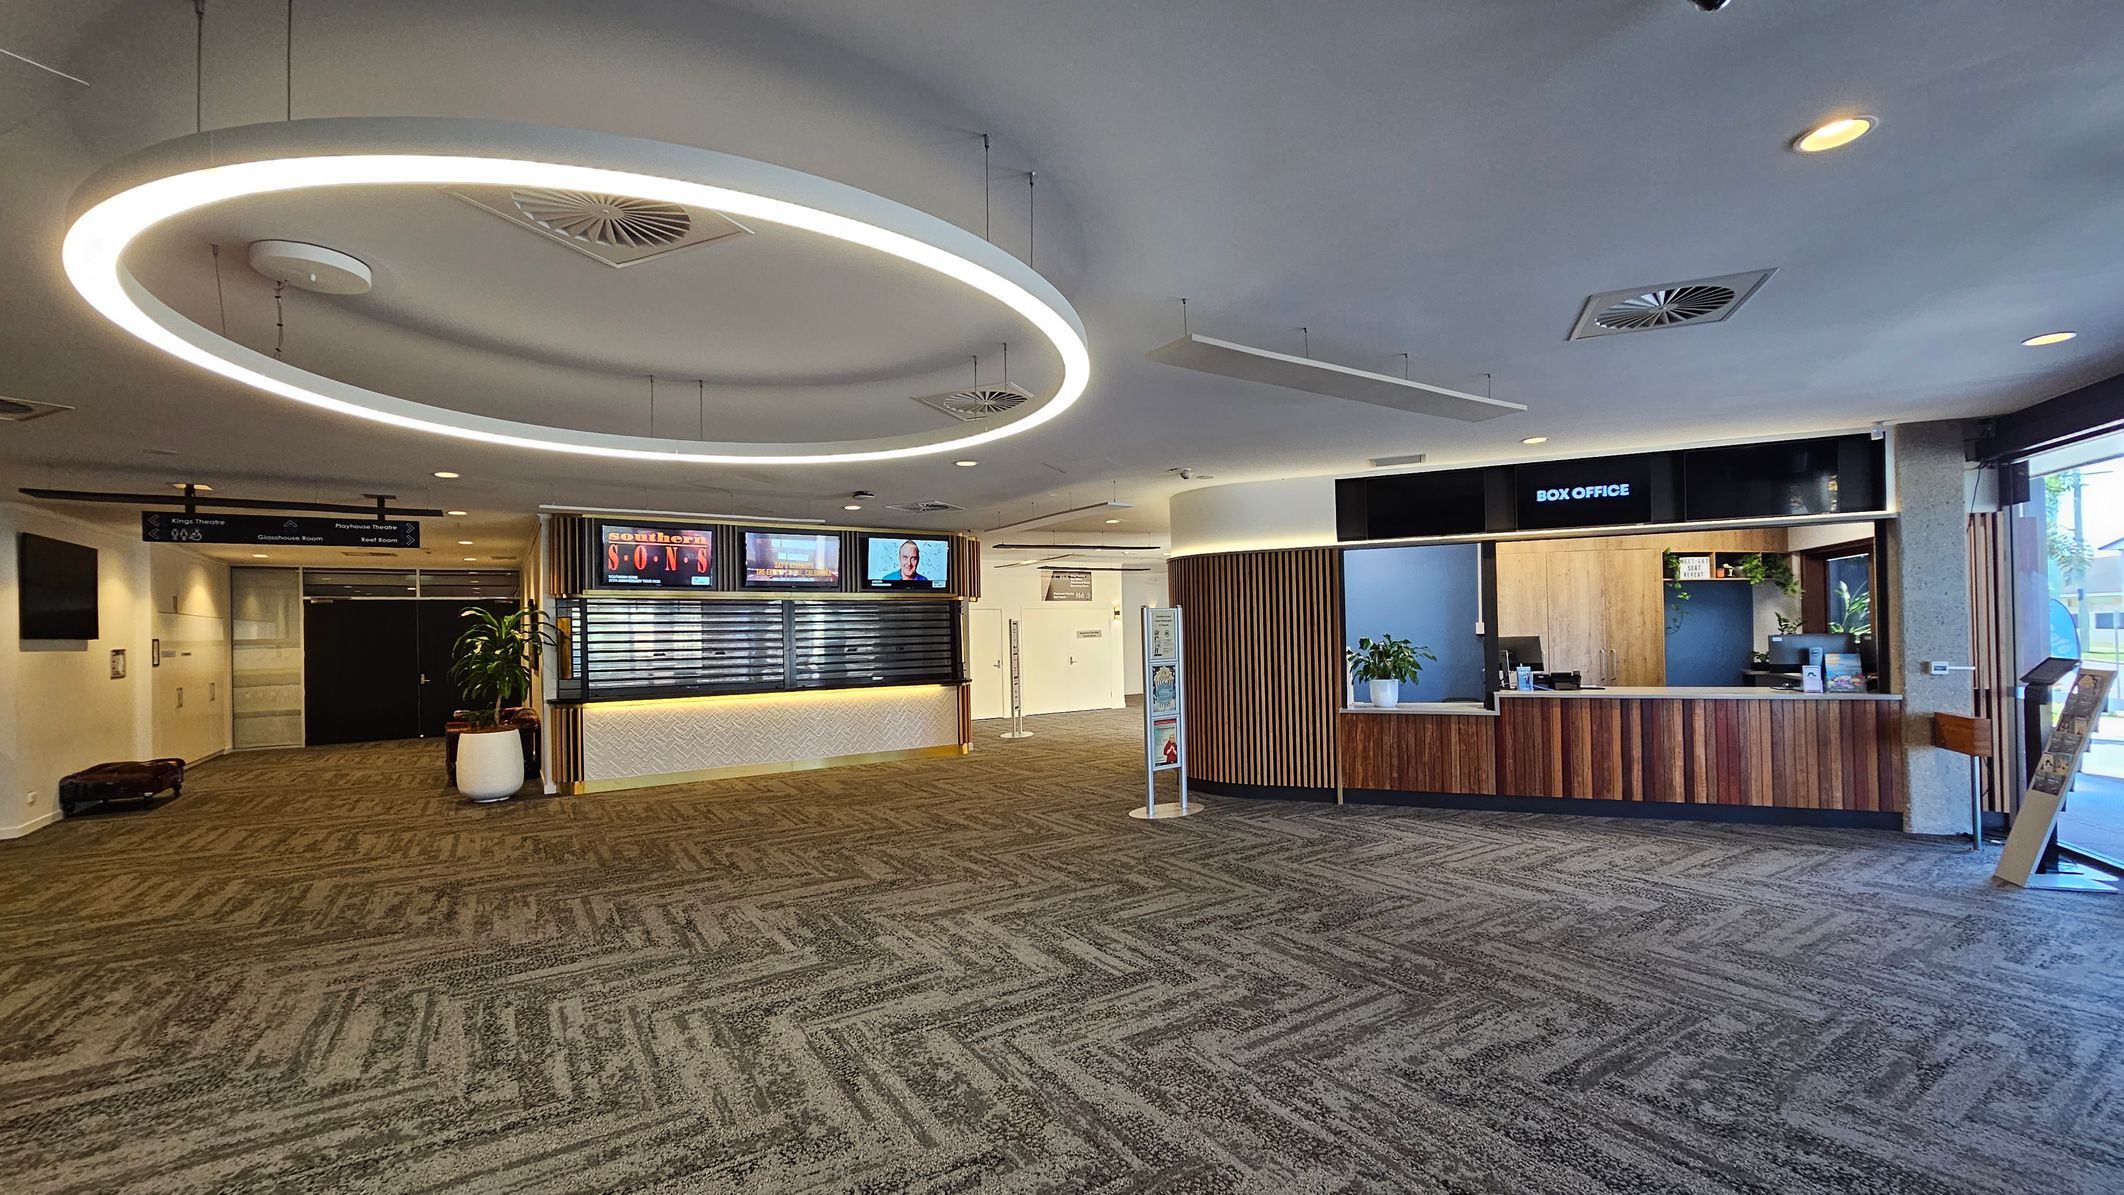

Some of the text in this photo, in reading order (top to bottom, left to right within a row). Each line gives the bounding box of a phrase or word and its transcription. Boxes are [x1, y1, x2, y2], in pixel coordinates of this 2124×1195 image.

[1536, 483, 1630, 502] BOX OFFICE
[608, 532, 707, 544] southern
